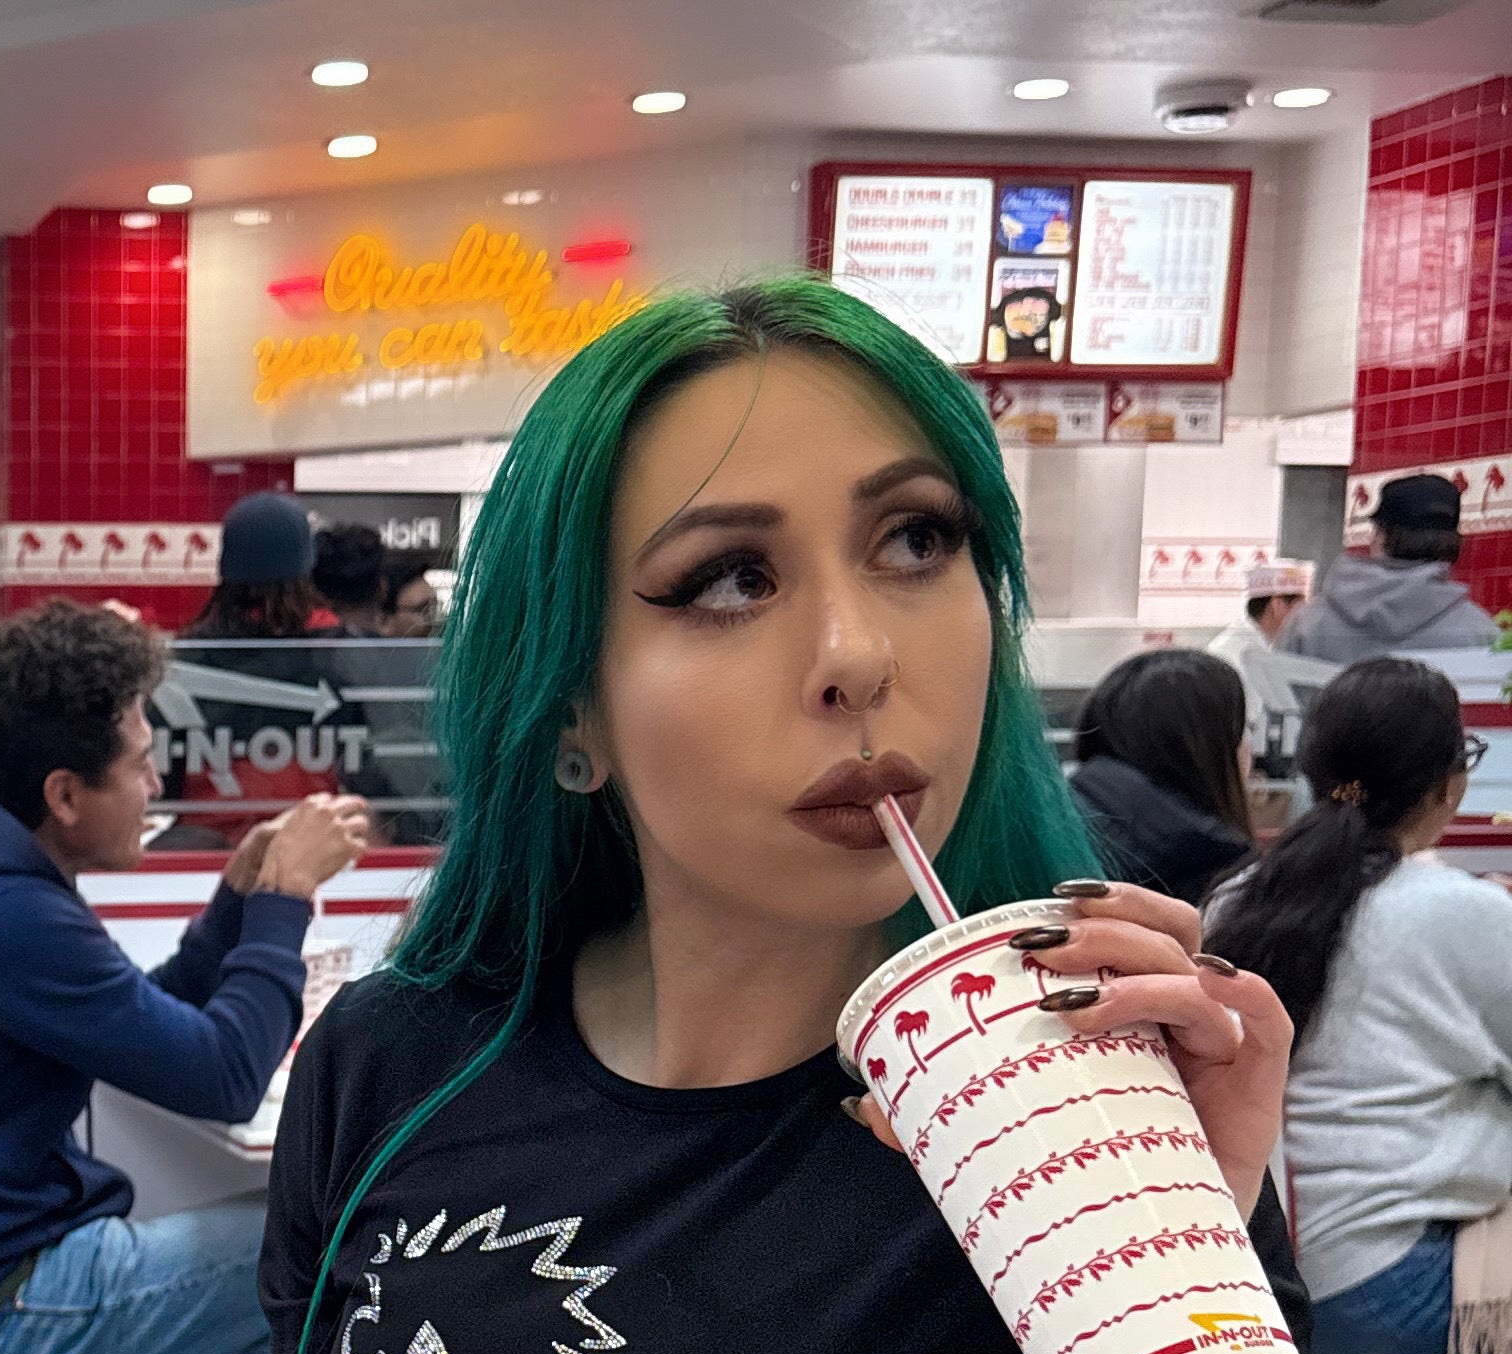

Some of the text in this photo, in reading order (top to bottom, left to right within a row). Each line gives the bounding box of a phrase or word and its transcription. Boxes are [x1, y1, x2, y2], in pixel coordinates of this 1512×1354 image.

[323, 223, 552, 316] Quality
[254, 278, 643, 404] you can tast
[151, 725, 368, 775] -N-OUT
[1196, 1325, 1270, 1349] IN-N-OUT
